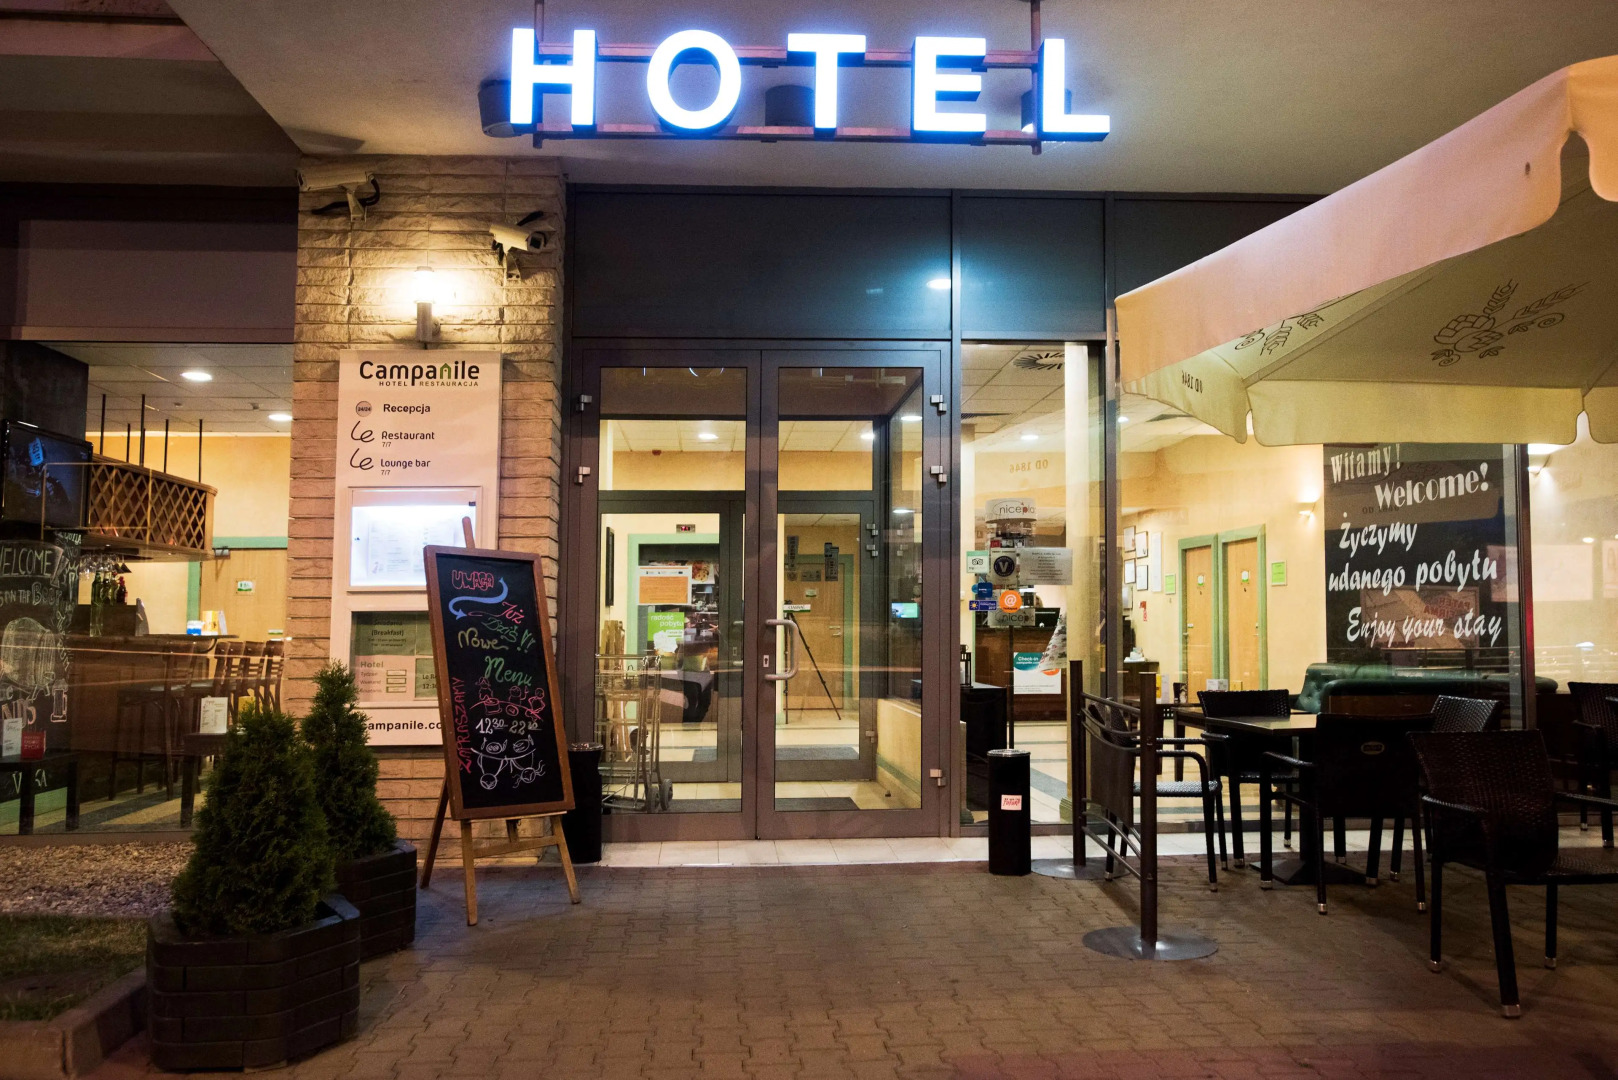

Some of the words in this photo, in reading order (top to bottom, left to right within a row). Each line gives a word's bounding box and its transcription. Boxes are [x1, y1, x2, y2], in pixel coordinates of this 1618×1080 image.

[509, 27, 1111, 135] HOTEL
[360, 360, 480, 387] Campanile
[383, 403, 431, 414] Recepcja
[381, 430, 435, 440] Restaurant
[380, 458, 413, 469] Lounge
[415, 458, 431, 467] bar
[1374, 462, 1489, 510] Welcome!
[1339, 511, 1418, 558] Życzymy
[1328, 563, 1406, 596] udanego
[1415, 549, 1498, 592] pobytu
[371, 629, 404, 637] (Breakfast)
[1346, 606, 1396, 648] Enjoy
[1402, 615, 1446, 644] your
[1453, 608, 1503, 647] stay
[484, 655, 533, 687] Menu
[368, 720, 442, 732] ampanile.co
